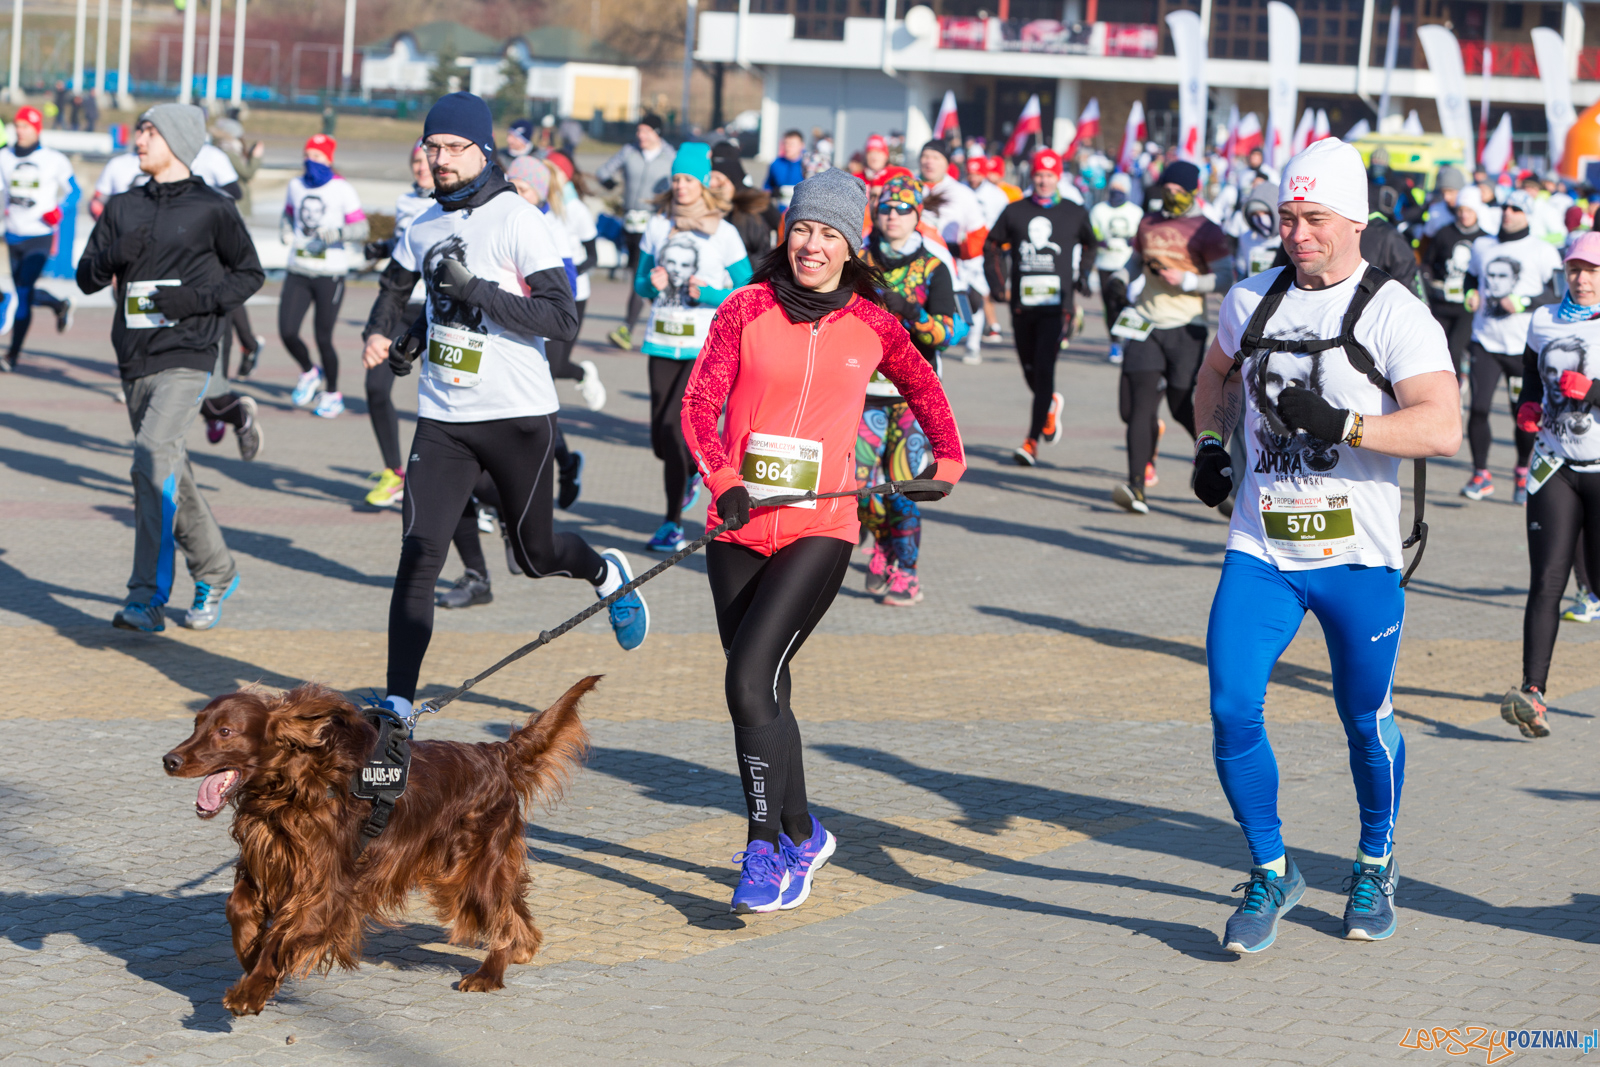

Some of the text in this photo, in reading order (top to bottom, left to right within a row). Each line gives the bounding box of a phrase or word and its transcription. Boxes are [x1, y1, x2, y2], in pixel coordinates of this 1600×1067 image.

[439, 344, 463, 364] 720
[755, 460, 793, 482] 964
[1273, 496, 1322, 506] TROPEMWILCZYM
[1287, 513, 1327, 533] 570
[1383, 620, 1400, 637] asics
